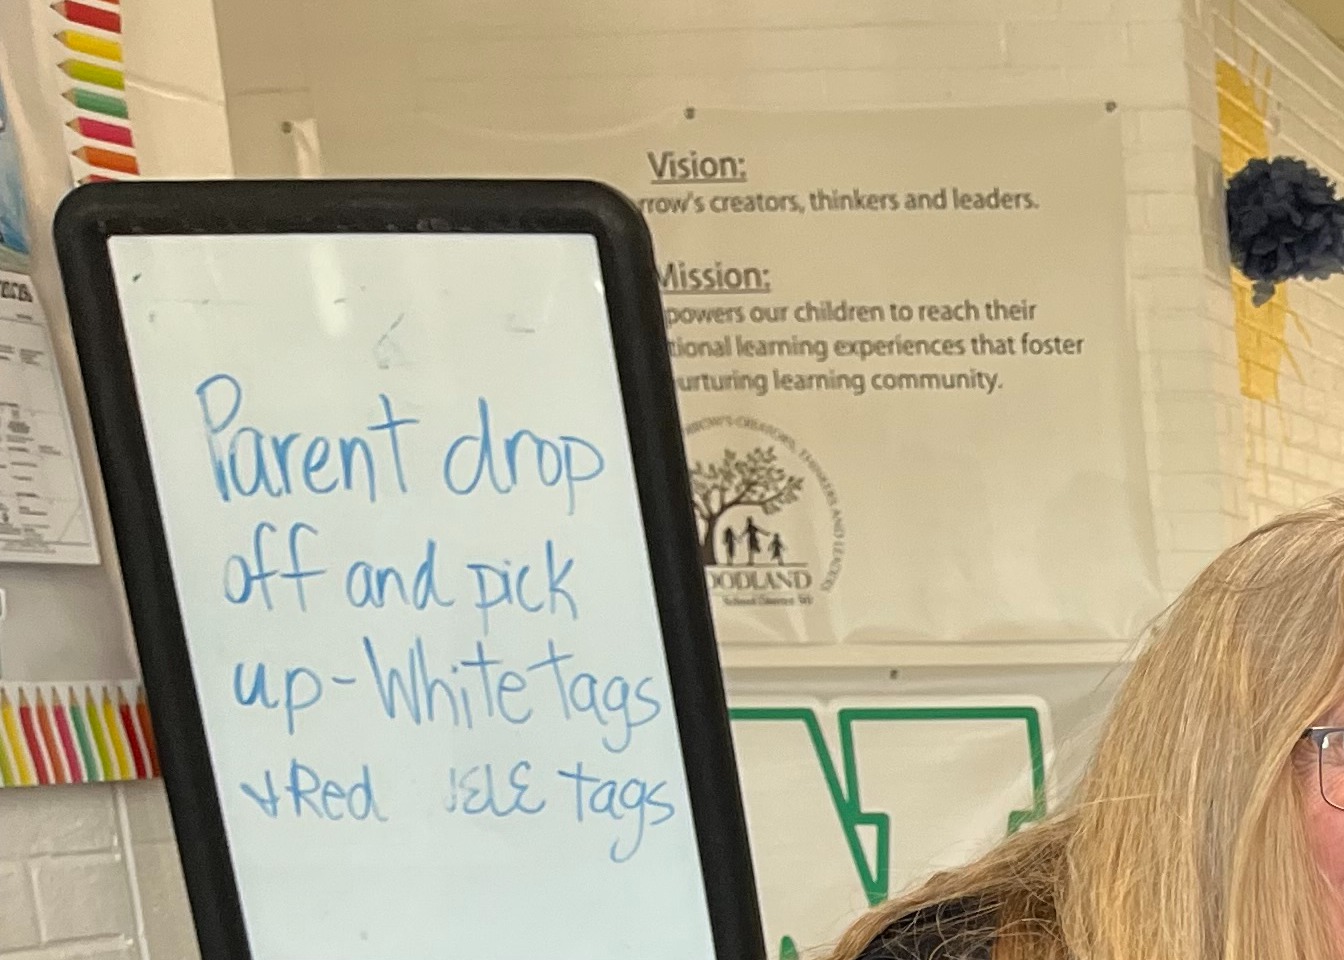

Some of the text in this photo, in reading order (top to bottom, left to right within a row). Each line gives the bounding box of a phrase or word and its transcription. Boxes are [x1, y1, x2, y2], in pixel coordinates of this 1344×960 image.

[647, 150, 747, 182] Vision:
[710, 193, 805, 214] creators,
[809, 187, 900, 212] thinkers
[904, 187, 947, 211] and
[952, 186, 1040, 211] leaders.
[750, 305, 789, 323] our
[793, 300, 885, 323] children
[890, 302, 914, 322] to
[918, 299, 980, 322] reach
[985, 298, 1037, 321] their
[735, 334, 828, 362] learning
[833, 334, 967, 361] experiences
[971, 332, 1016, 355] that
[1021, 331, 1085, 355] foster
[773, 368, 865, 396] learning
[871, 368, 1003, 395] community.
[195, 373, 420, 502] Parent
[443, 397, 605, 516] drop
[223, 521, 579, 635] off and pick
[527, 639, 662, 754] tags
[558, 761, 676, 864] tags
